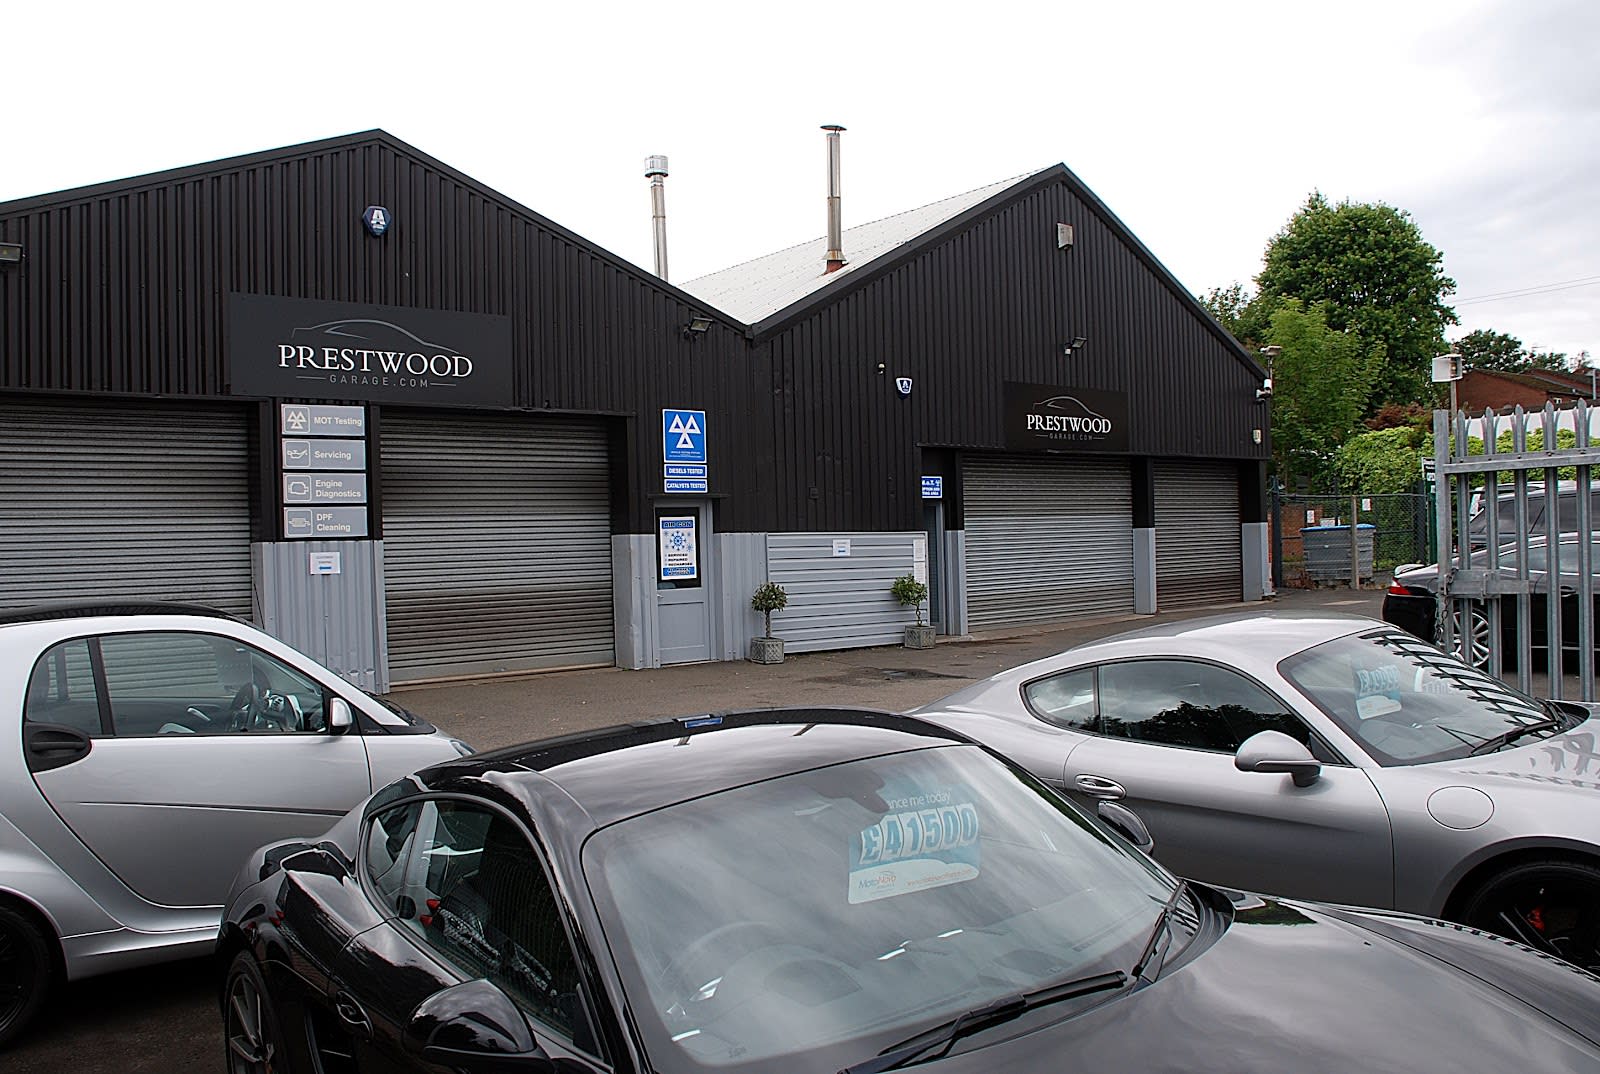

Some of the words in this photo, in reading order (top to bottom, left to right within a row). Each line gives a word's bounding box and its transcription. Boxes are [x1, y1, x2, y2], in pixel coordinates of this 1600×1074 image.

[278, 344, 473, 378] PRESTWOOD
[329, 374, 429, 388] GARAGE.COM
[313, 416, 332, 425] MOT
[334, 417, 363, 427] Testing
[1026, 414, 1112, 433] PRESTWOOD
[1049, 433, 1093, 441] GARAGE.COM
[314, 450, 352, 461] Servicing
[315, 479, 343, 489] Engine
[315, 489, 362, 499] Diagnostics
[316, 513, 333, 521] DPF
[316, 523, 351, 532] Cleaning
[909, 795, 926, 807] me
[926, 790, 951, 804] today
[862, 806, 978, 862] £41500
